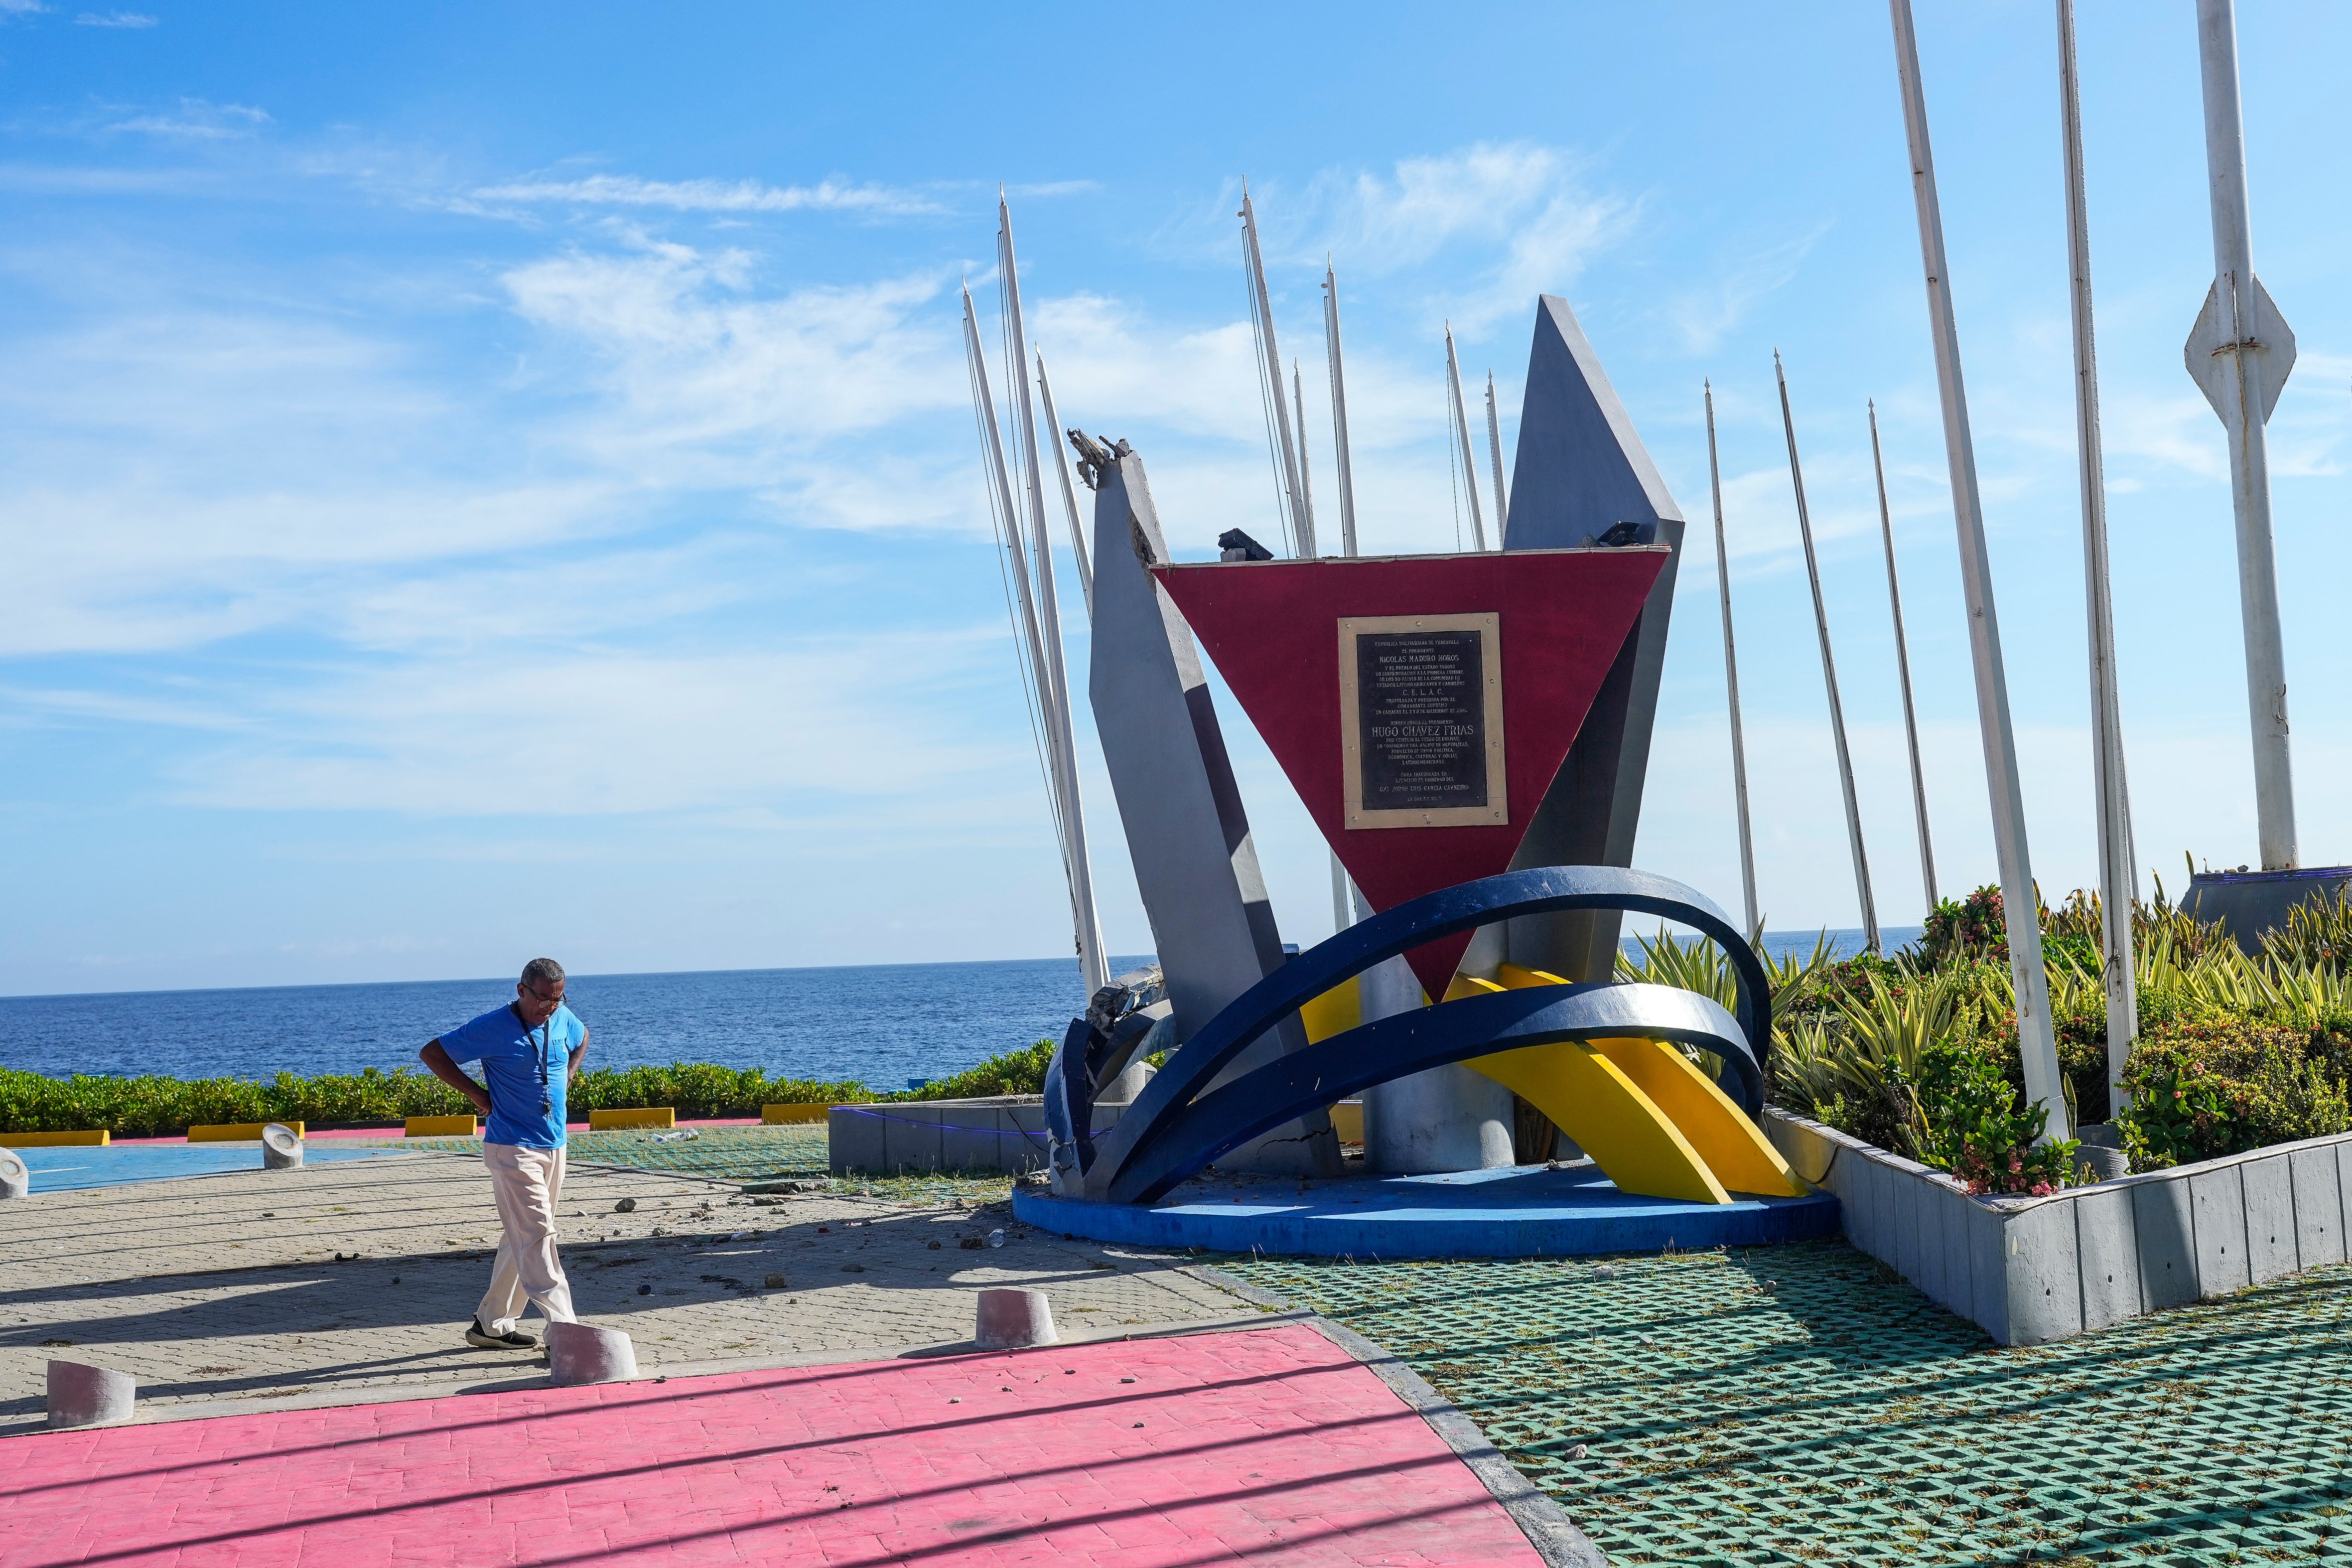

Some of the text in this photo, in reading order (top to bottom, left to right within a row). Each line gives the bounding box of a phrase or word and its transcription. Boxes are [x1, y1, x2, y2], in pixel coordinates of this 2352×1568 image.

[1372, 725, 1474, 737] HUGO CHAVEZ FRIAS
